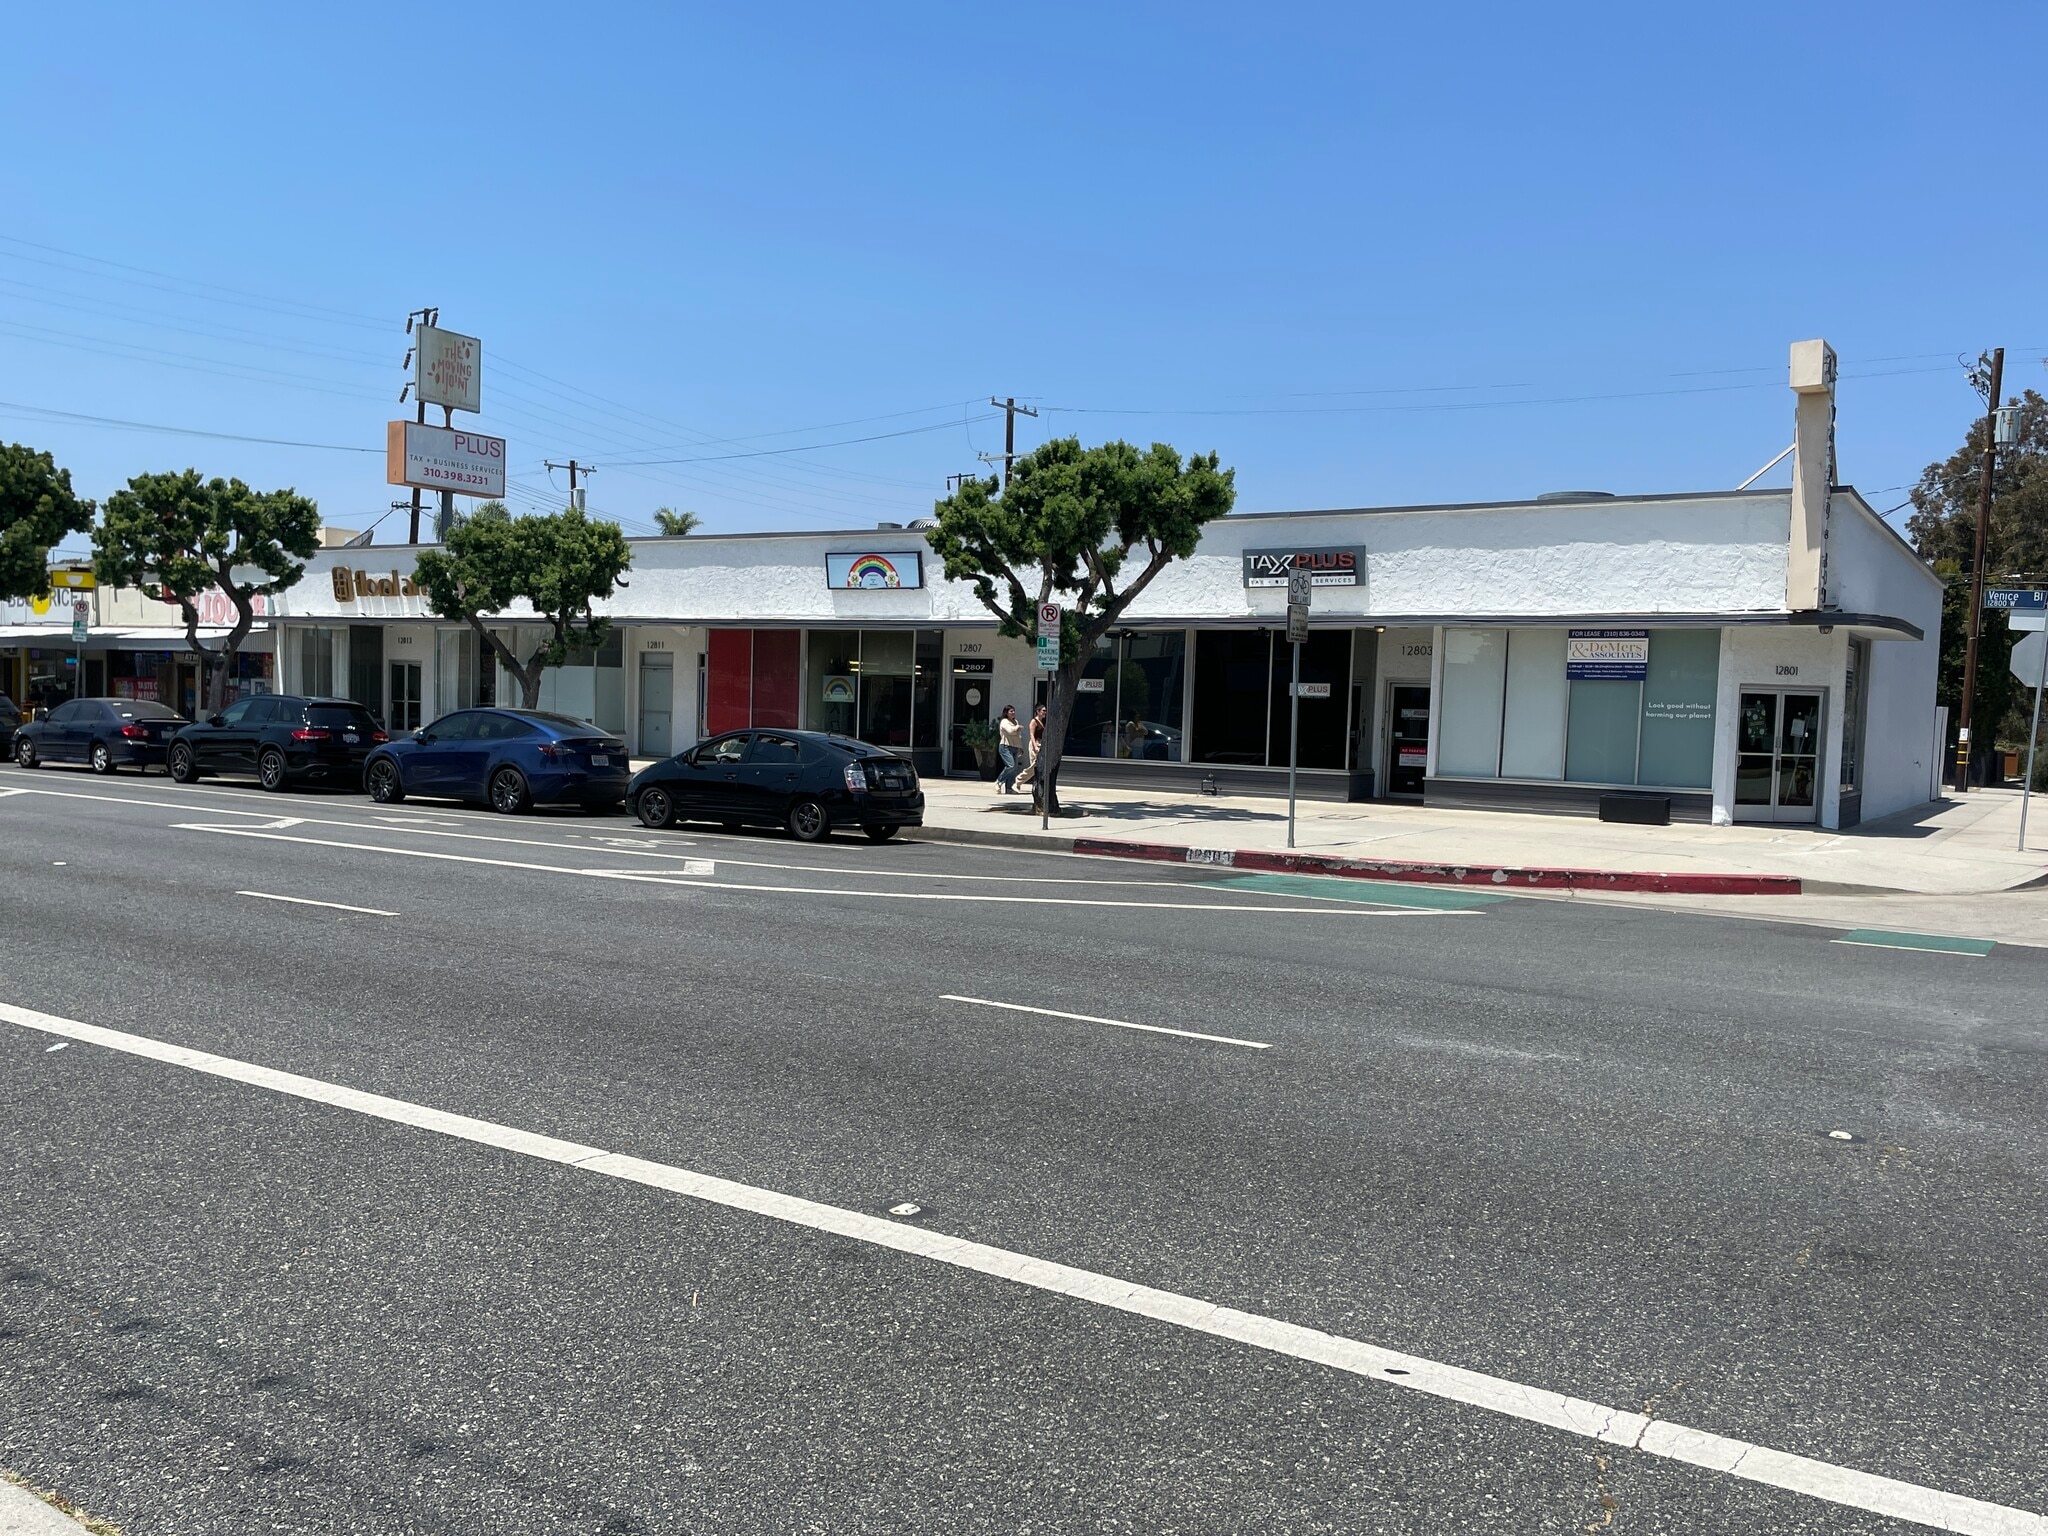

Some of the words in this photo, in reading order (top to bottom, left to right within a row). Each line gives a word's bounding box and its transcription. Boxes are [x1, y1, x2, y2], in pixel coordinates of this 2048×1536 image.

[445, 341, 463, 362] THE
[438, 359, 472, 384] MOVING
[443, 373, 469, 398] JOINT
[454, 434, 501, 458] PLUS
[410, 454, 423, 462] TAX
[433, 458, 469, 470] BUSINESS
[471, 465, 503, 476] SERVICES
[423, 467, 488, 486] 310.398.3231
[1988, 591, 2019, 601] Venice
[192, 593, 265, 626] LIQUR
[647, 641, 664, 649] 12811
[959, 644, 982, 653] 12807
[1401, 645, 1432, 655] 12803
[1588, 643, 1642, 652] DeMers
[1776, 665, 1798, 676] 12801
[137, 681, 152, 689] TASTE
[1645, 711, 1674, 719] harming
